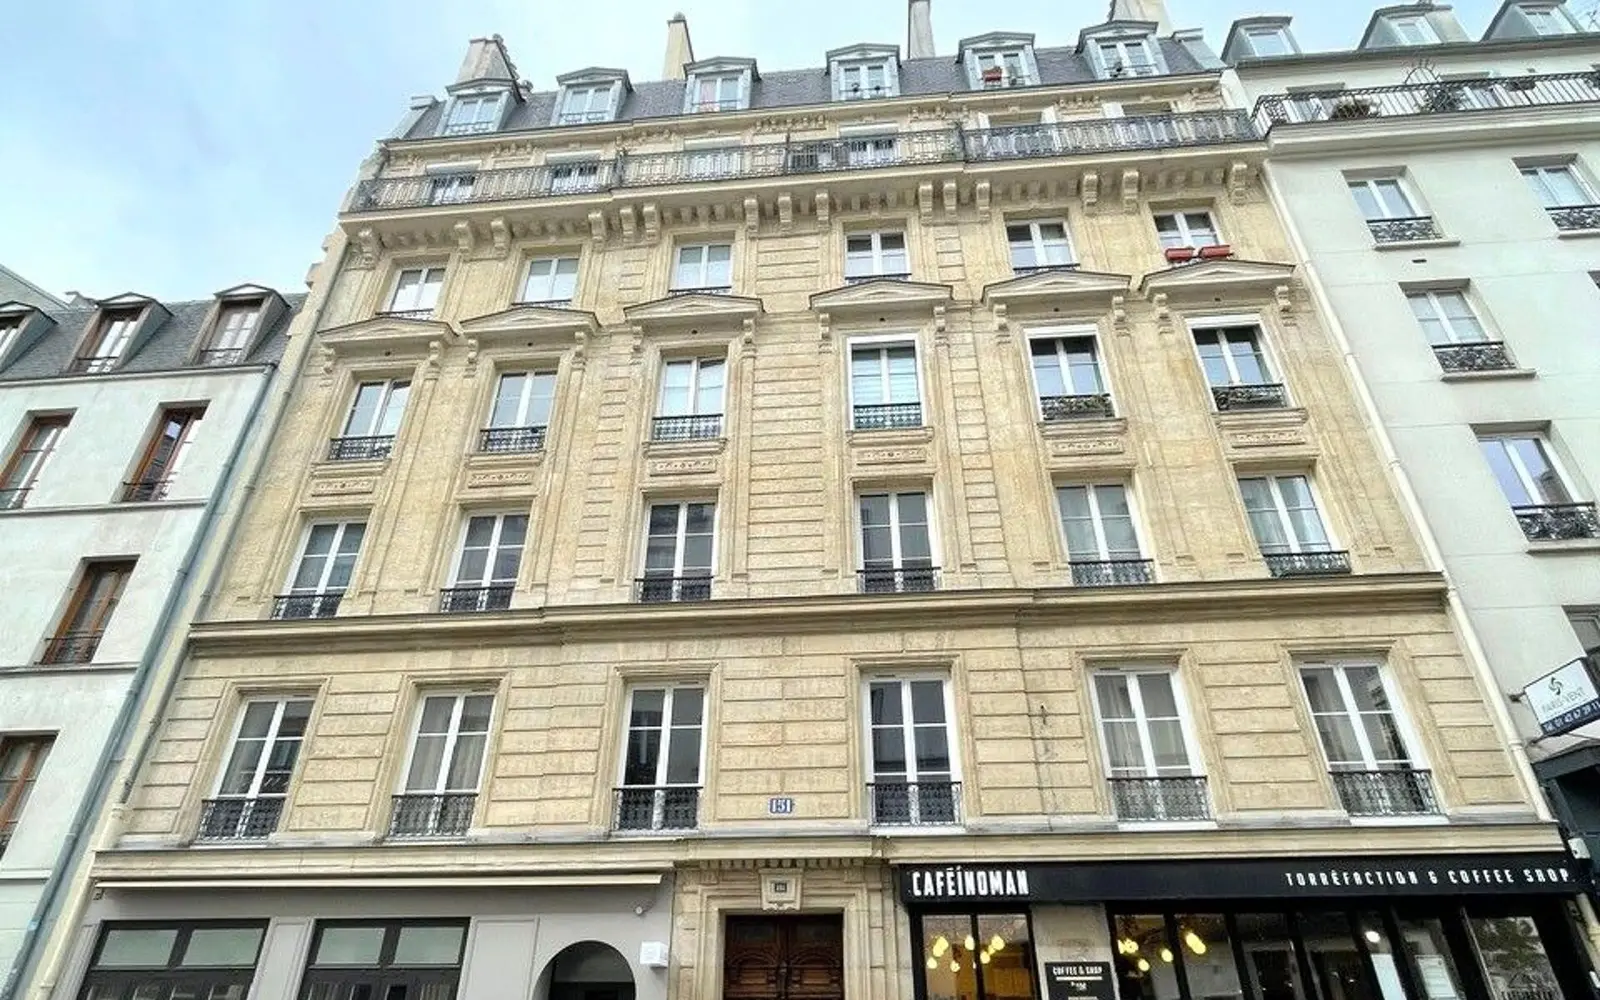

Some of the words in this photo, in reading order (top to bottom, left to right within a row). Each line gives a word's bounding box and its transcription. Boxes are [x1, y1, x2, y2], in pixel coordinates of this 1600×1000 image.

[772, 799, 791, 813] 151
[1447, 869, 1514, 884] COFFEE
[1523, 868, 1568, 883] SHOP
